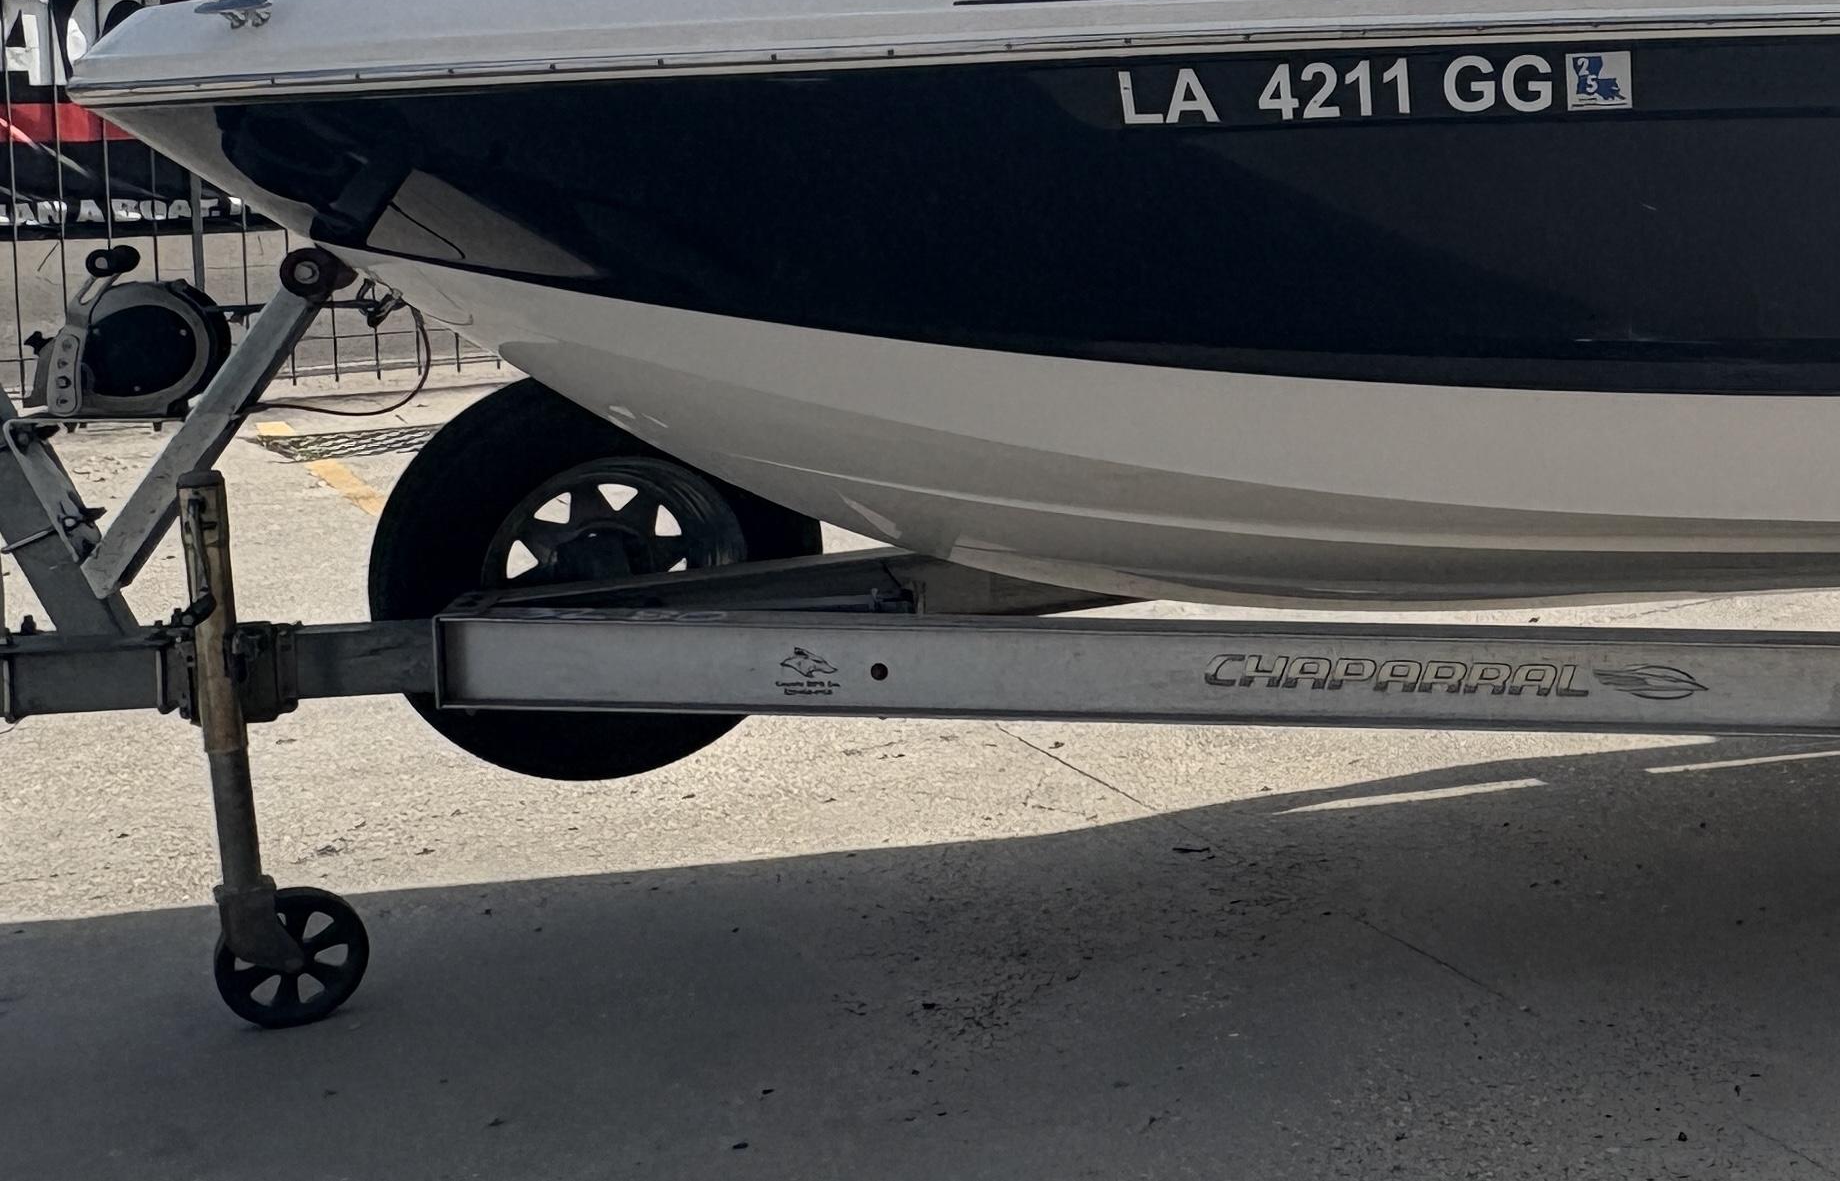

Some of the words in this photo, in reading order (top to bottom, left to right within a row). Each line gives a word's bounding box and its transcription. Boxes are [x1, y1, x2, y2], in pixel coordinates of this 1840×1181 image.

[1118, 68, 1220, 124] LA
[1258, 57, 1411, 120] 4211
[1444, 54, 1554, 113] GG
[1204, 653, 1590, 697] CHAPARRAL
